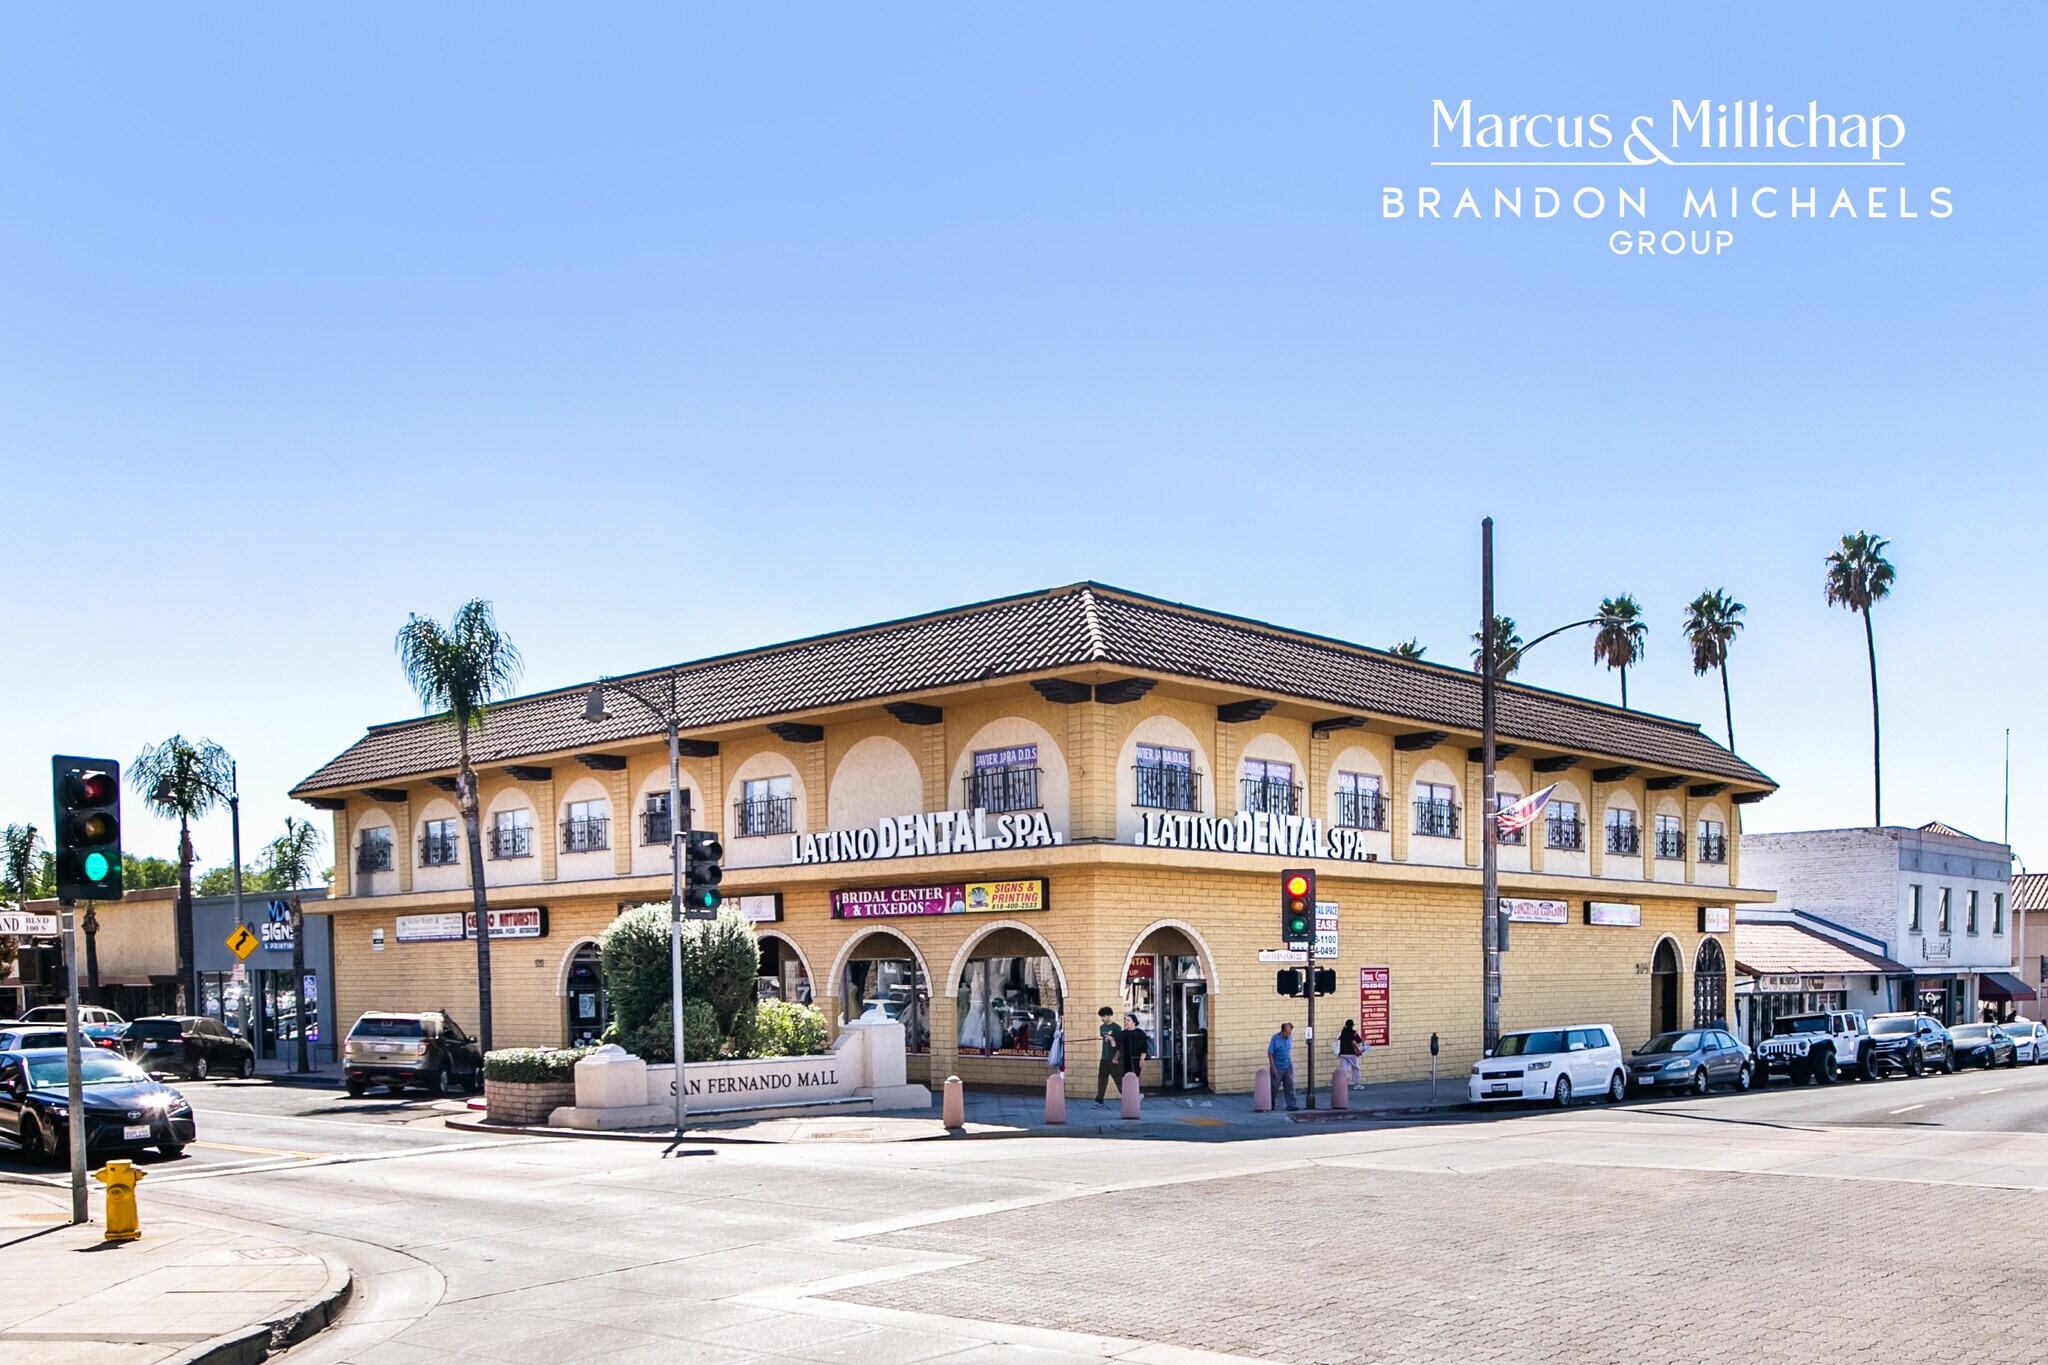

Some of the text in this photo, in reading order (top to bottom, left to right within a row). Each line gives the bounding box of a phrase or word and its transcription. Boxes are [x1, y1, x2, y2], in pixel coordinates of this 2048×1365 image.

[791, 828, 877, 864] LATINO
[879, 808, 993, 858] DENTAL
[1144, 811, 1367, 861] LATINO DENTAL SPA
[841, 887, 944, 904] BRIDAL CENTER
[994, 882, 1034, 894] SIGNS &
[991, 892, 1038, 904] PRINTING
[852, 901, 925, 917] & TUXEDOS
[0, 917, 20, 931] ND
[707, 1073, 792, 1094] FERNANDO
[797, 1070, 839, 1087] MALL
